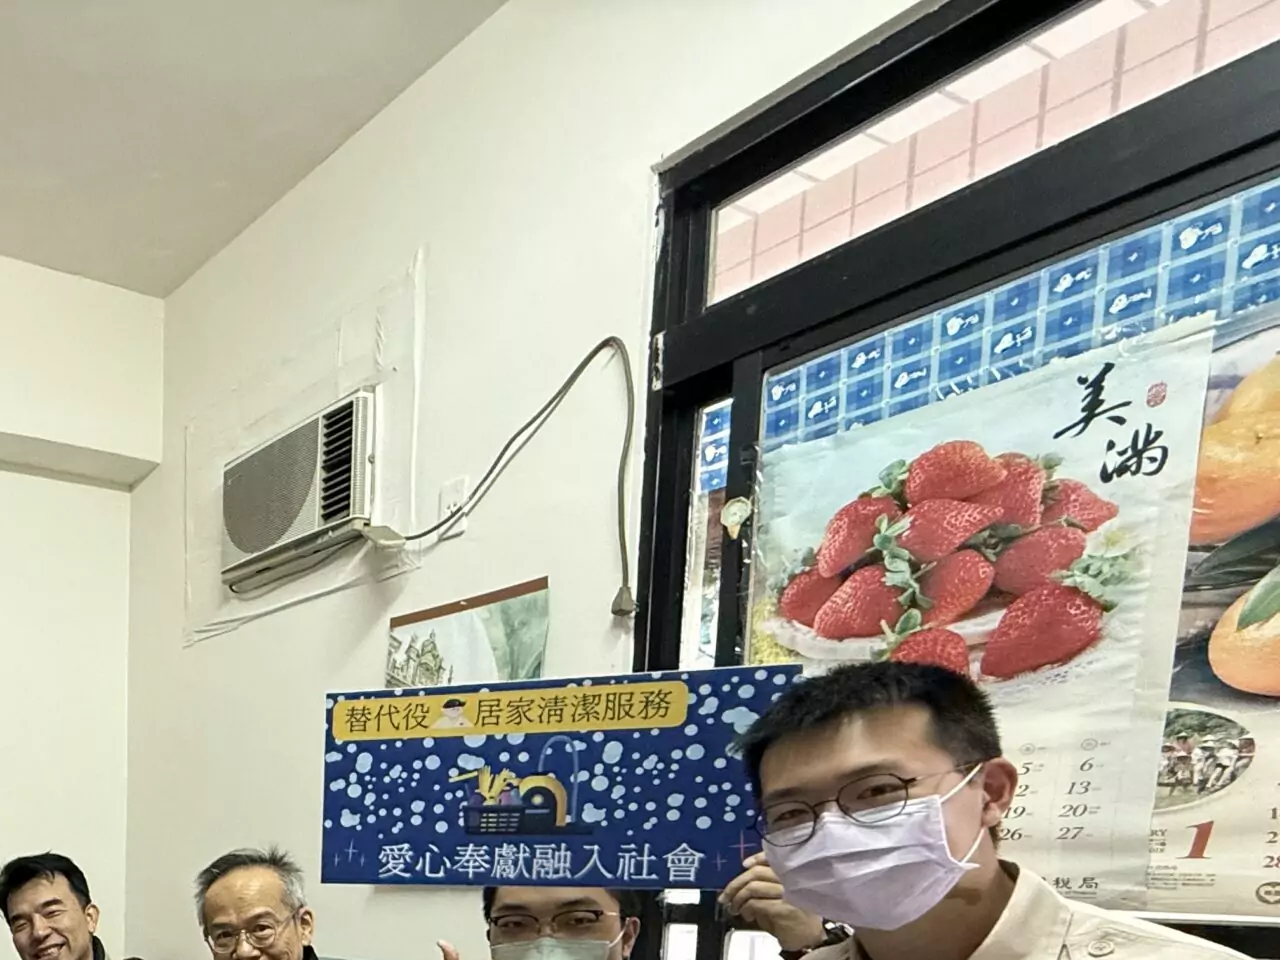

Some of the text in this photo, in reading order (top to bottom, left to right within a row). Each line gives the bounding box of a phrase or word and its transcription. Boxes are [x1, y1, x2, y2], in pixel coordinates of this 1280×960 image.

[345, 687, 672, 734] 替代役 居家清潔服務
[1079, 757, 1095, 772] 6
[1066, 780, 1092, 796] 13
[1003, 803, 1088, 820] 19 20
[1000, 826, 1084, 841] 26 27
[1176, 819, 1215, 860] 1
[378, 839, 708, 883] 愛心奉獻融入社會
